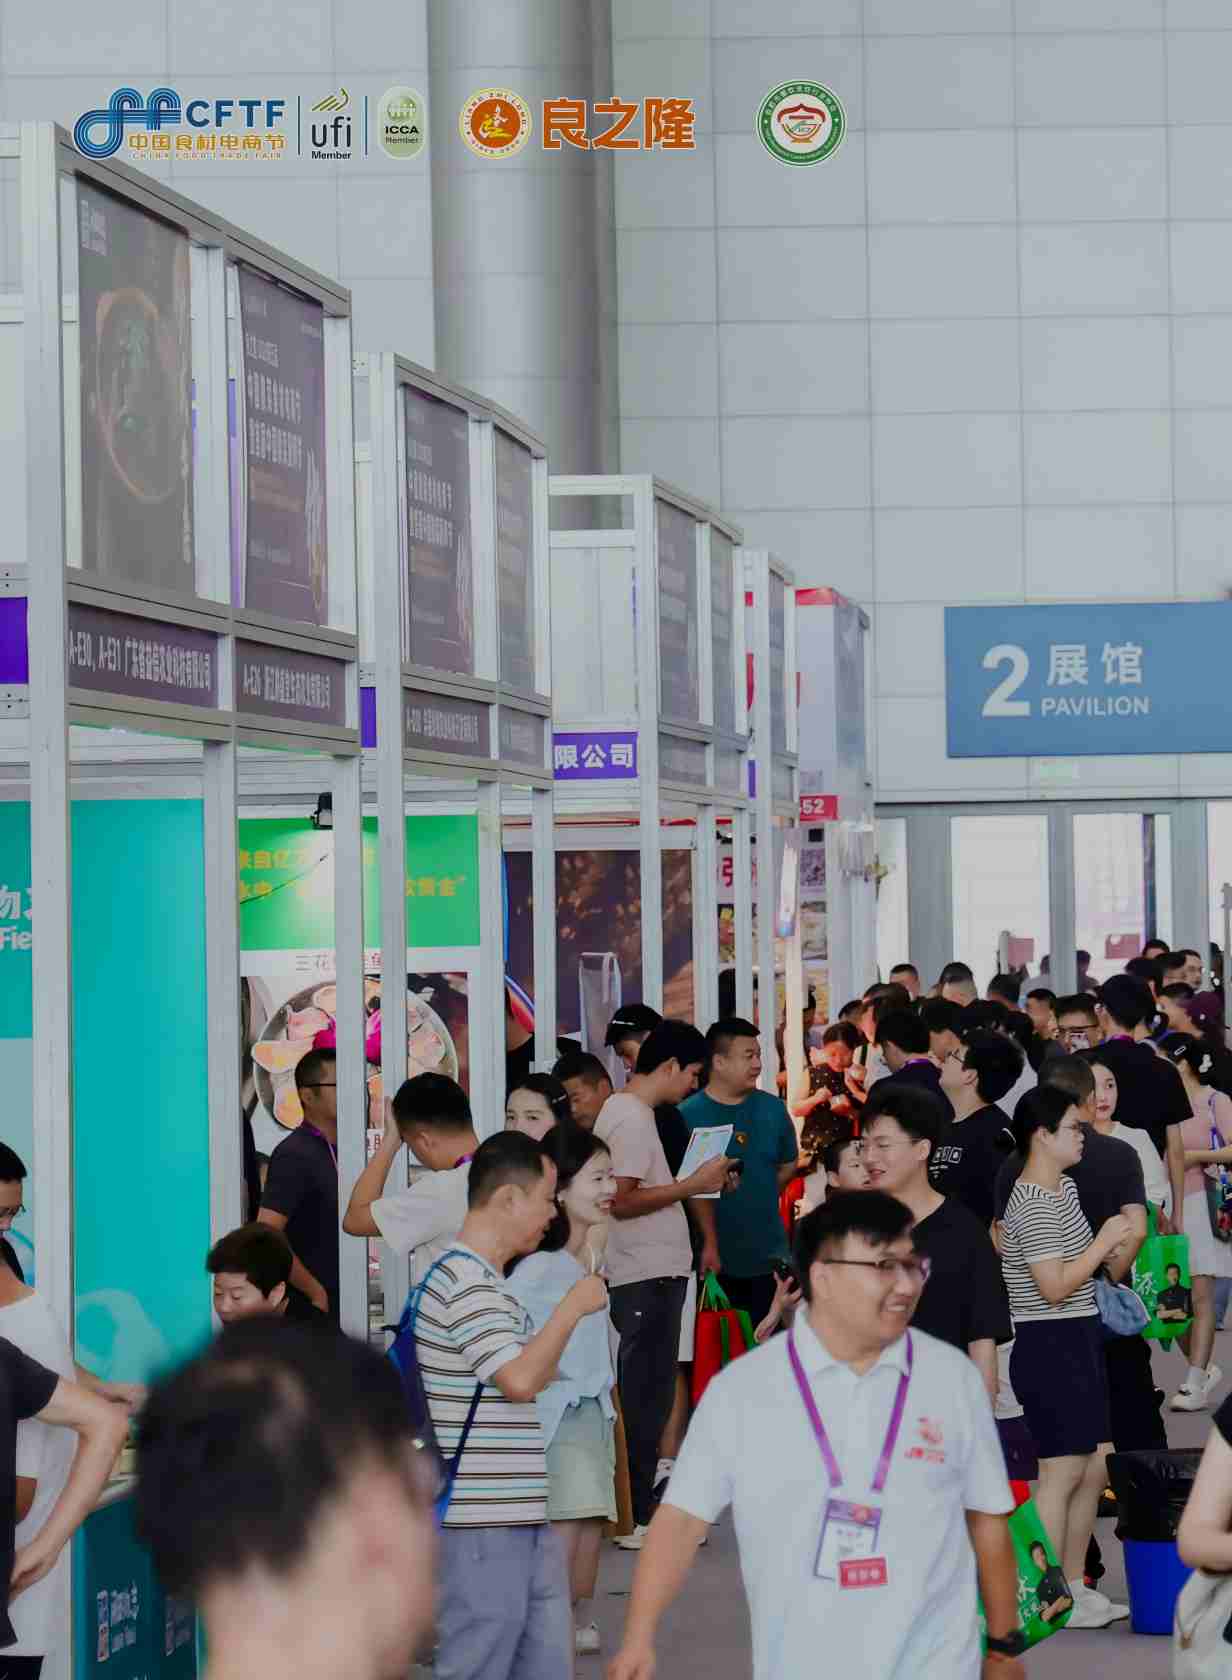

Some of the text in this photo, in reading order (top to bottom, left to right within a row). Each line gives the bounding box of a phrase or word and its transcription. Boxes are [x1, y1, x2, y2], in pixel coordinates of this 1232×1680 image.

[982, 642, 1143, 717] 2 展馆
[1041, 696, 1149, 717] PAVILION
[554, 743, 633, 769] 限公司
